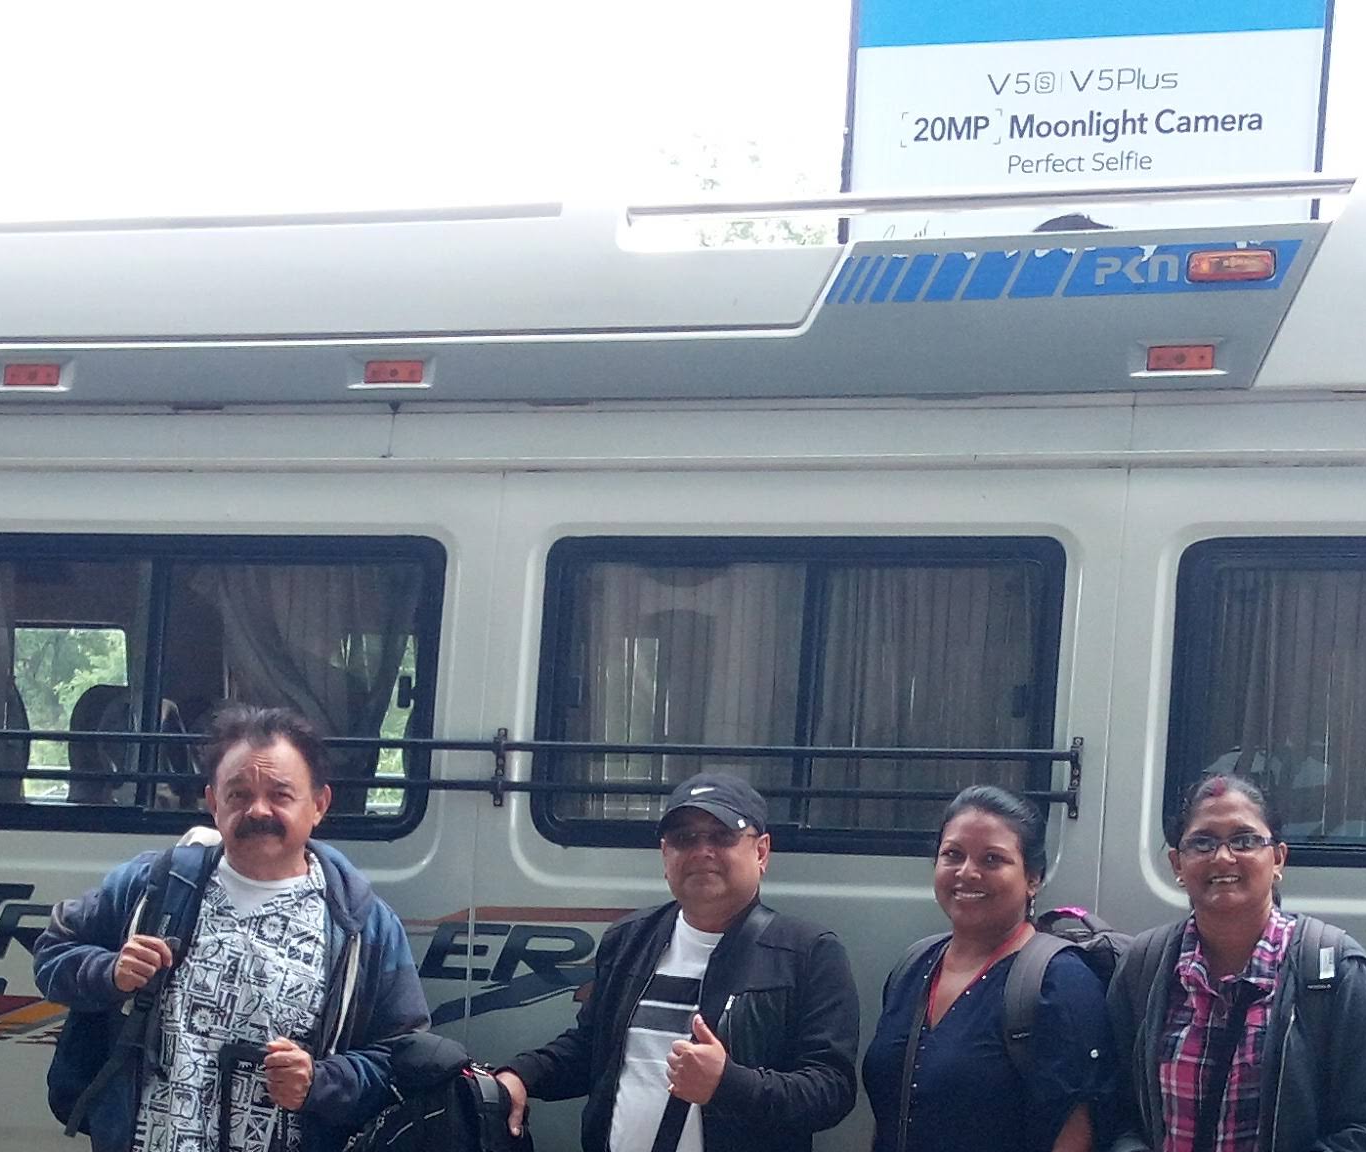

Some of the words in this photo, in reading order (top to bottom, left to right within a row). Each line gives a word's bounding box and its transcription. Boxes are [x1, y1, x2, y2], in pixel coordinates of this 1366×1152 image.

[1070, 67, 1179, 92] V5Plus
[913, 115, 990, 142] 20MP
[1008, 108, 1149, 144] Moonlight
[1154, 108, 1264, 135] Camera
[1007, 152, 1085, 175] Perfect
[1091, 150, 1153, 172] Selfie
